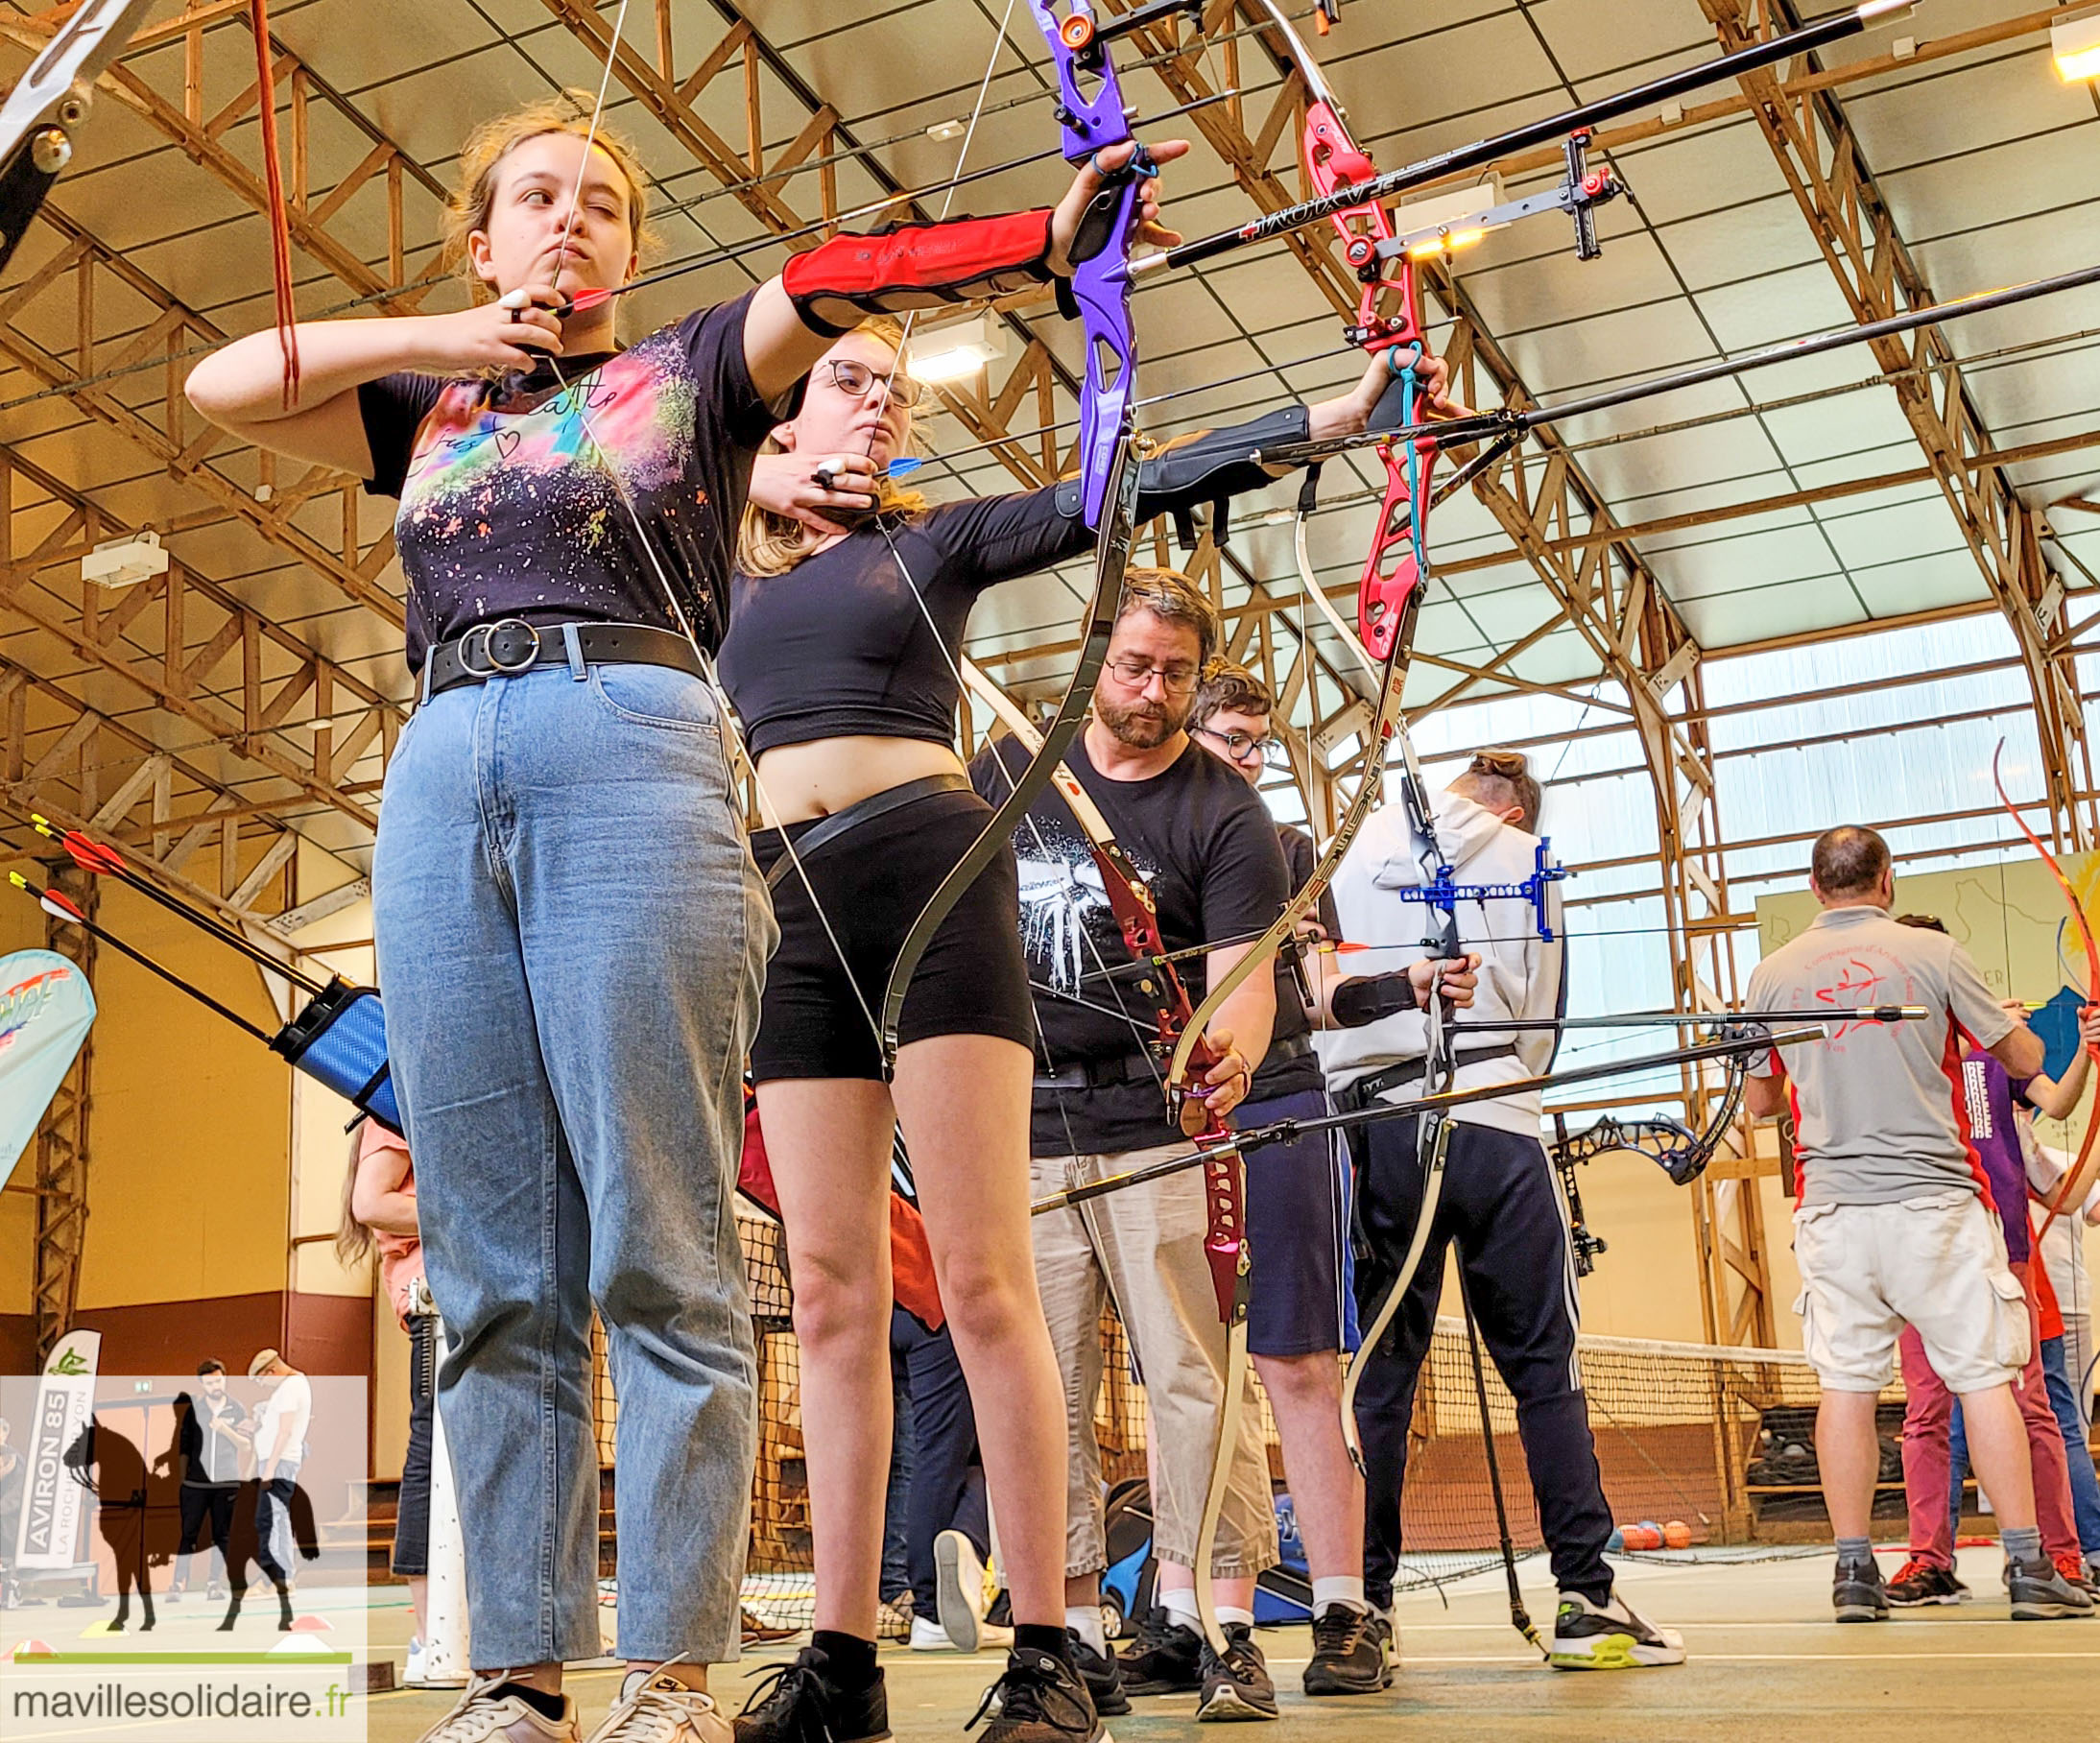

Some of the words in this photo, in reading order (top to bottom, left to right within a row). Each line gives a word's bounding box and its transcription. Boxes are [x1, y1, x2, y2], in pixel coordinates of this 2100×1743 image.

[30, 1436, 60, 1549] AVIRON
[45, 1393, 65, 1429] 85
[58, 1535, 70, 1555] LA
[73, 1392, 86, 1427] YON
